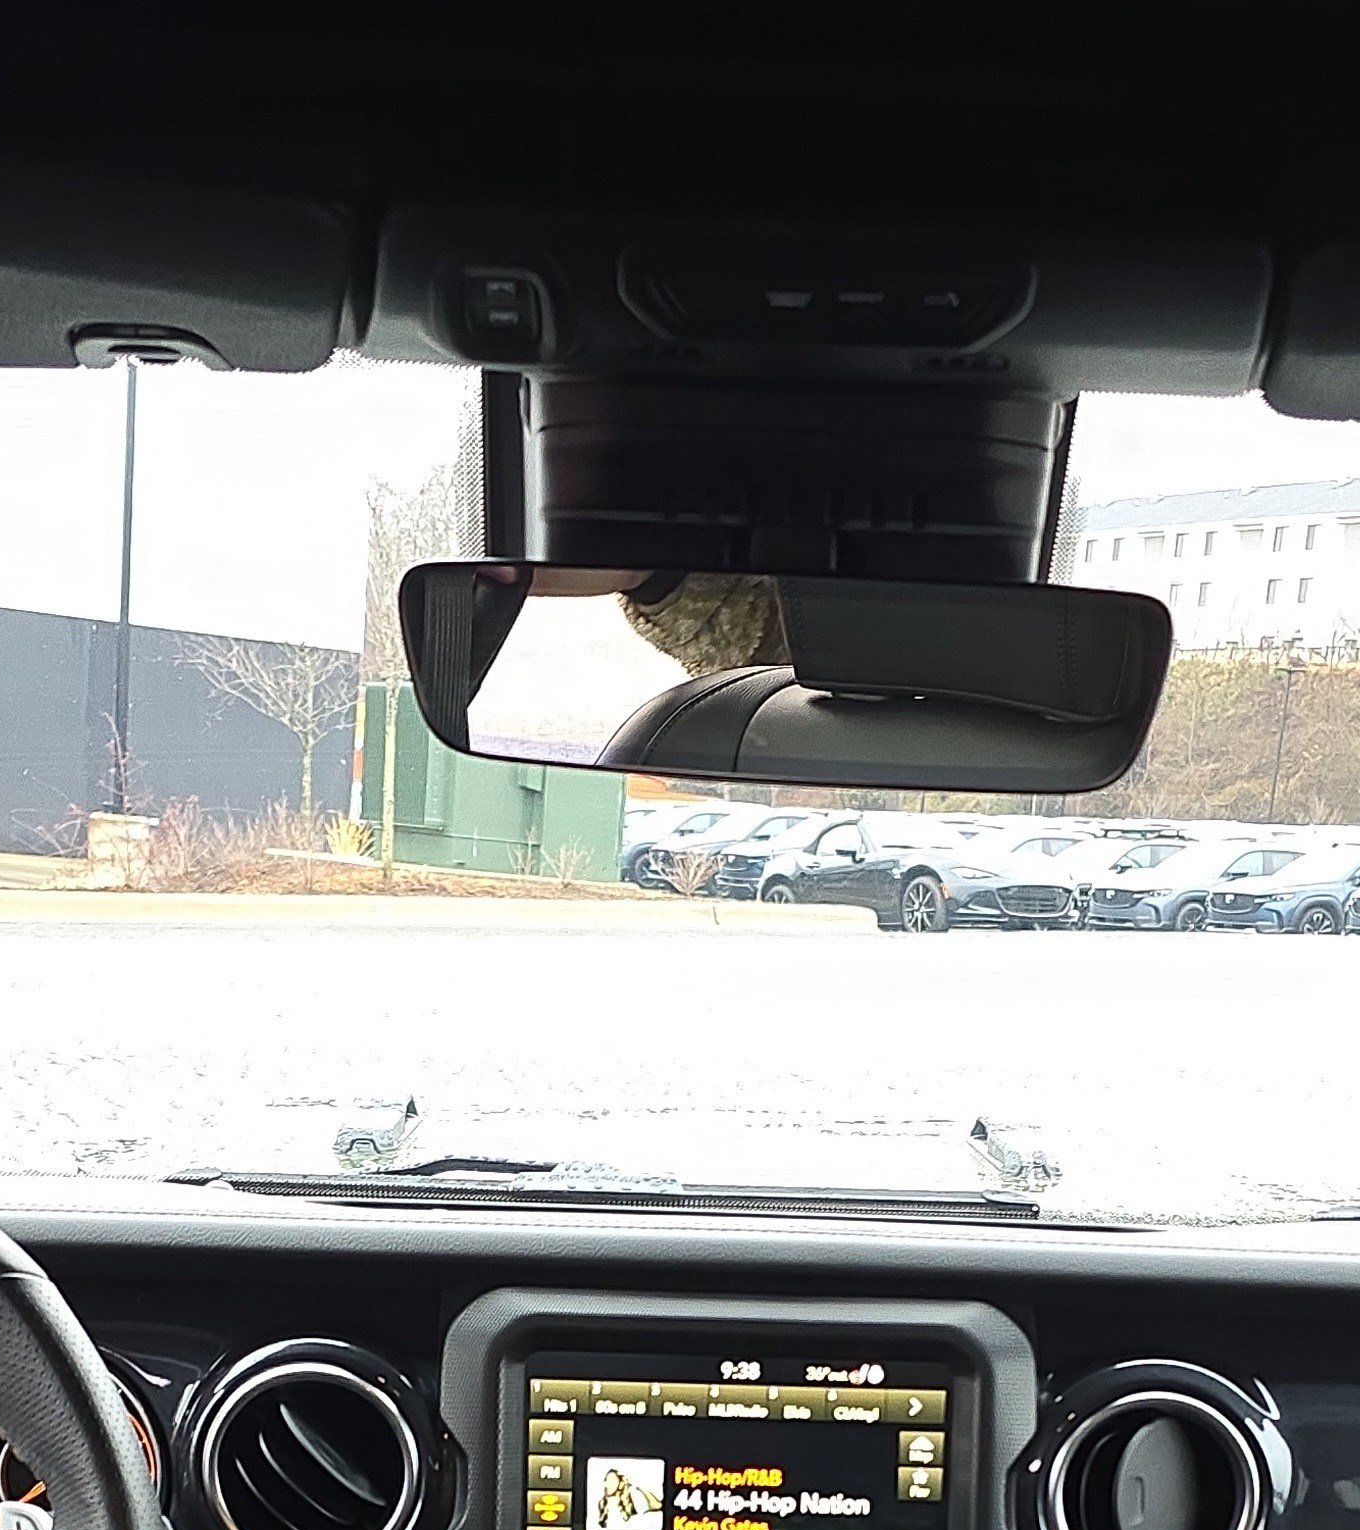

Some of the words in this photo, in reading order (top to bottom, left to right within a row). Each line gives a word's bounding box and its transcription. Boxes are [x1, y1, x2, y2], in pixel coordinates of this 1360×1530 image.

[674, 1488, 703, 1510] 44
[706, 1489, 797, 1517] Hip-Hop
[799, 1491, 871, 1516] Nation
